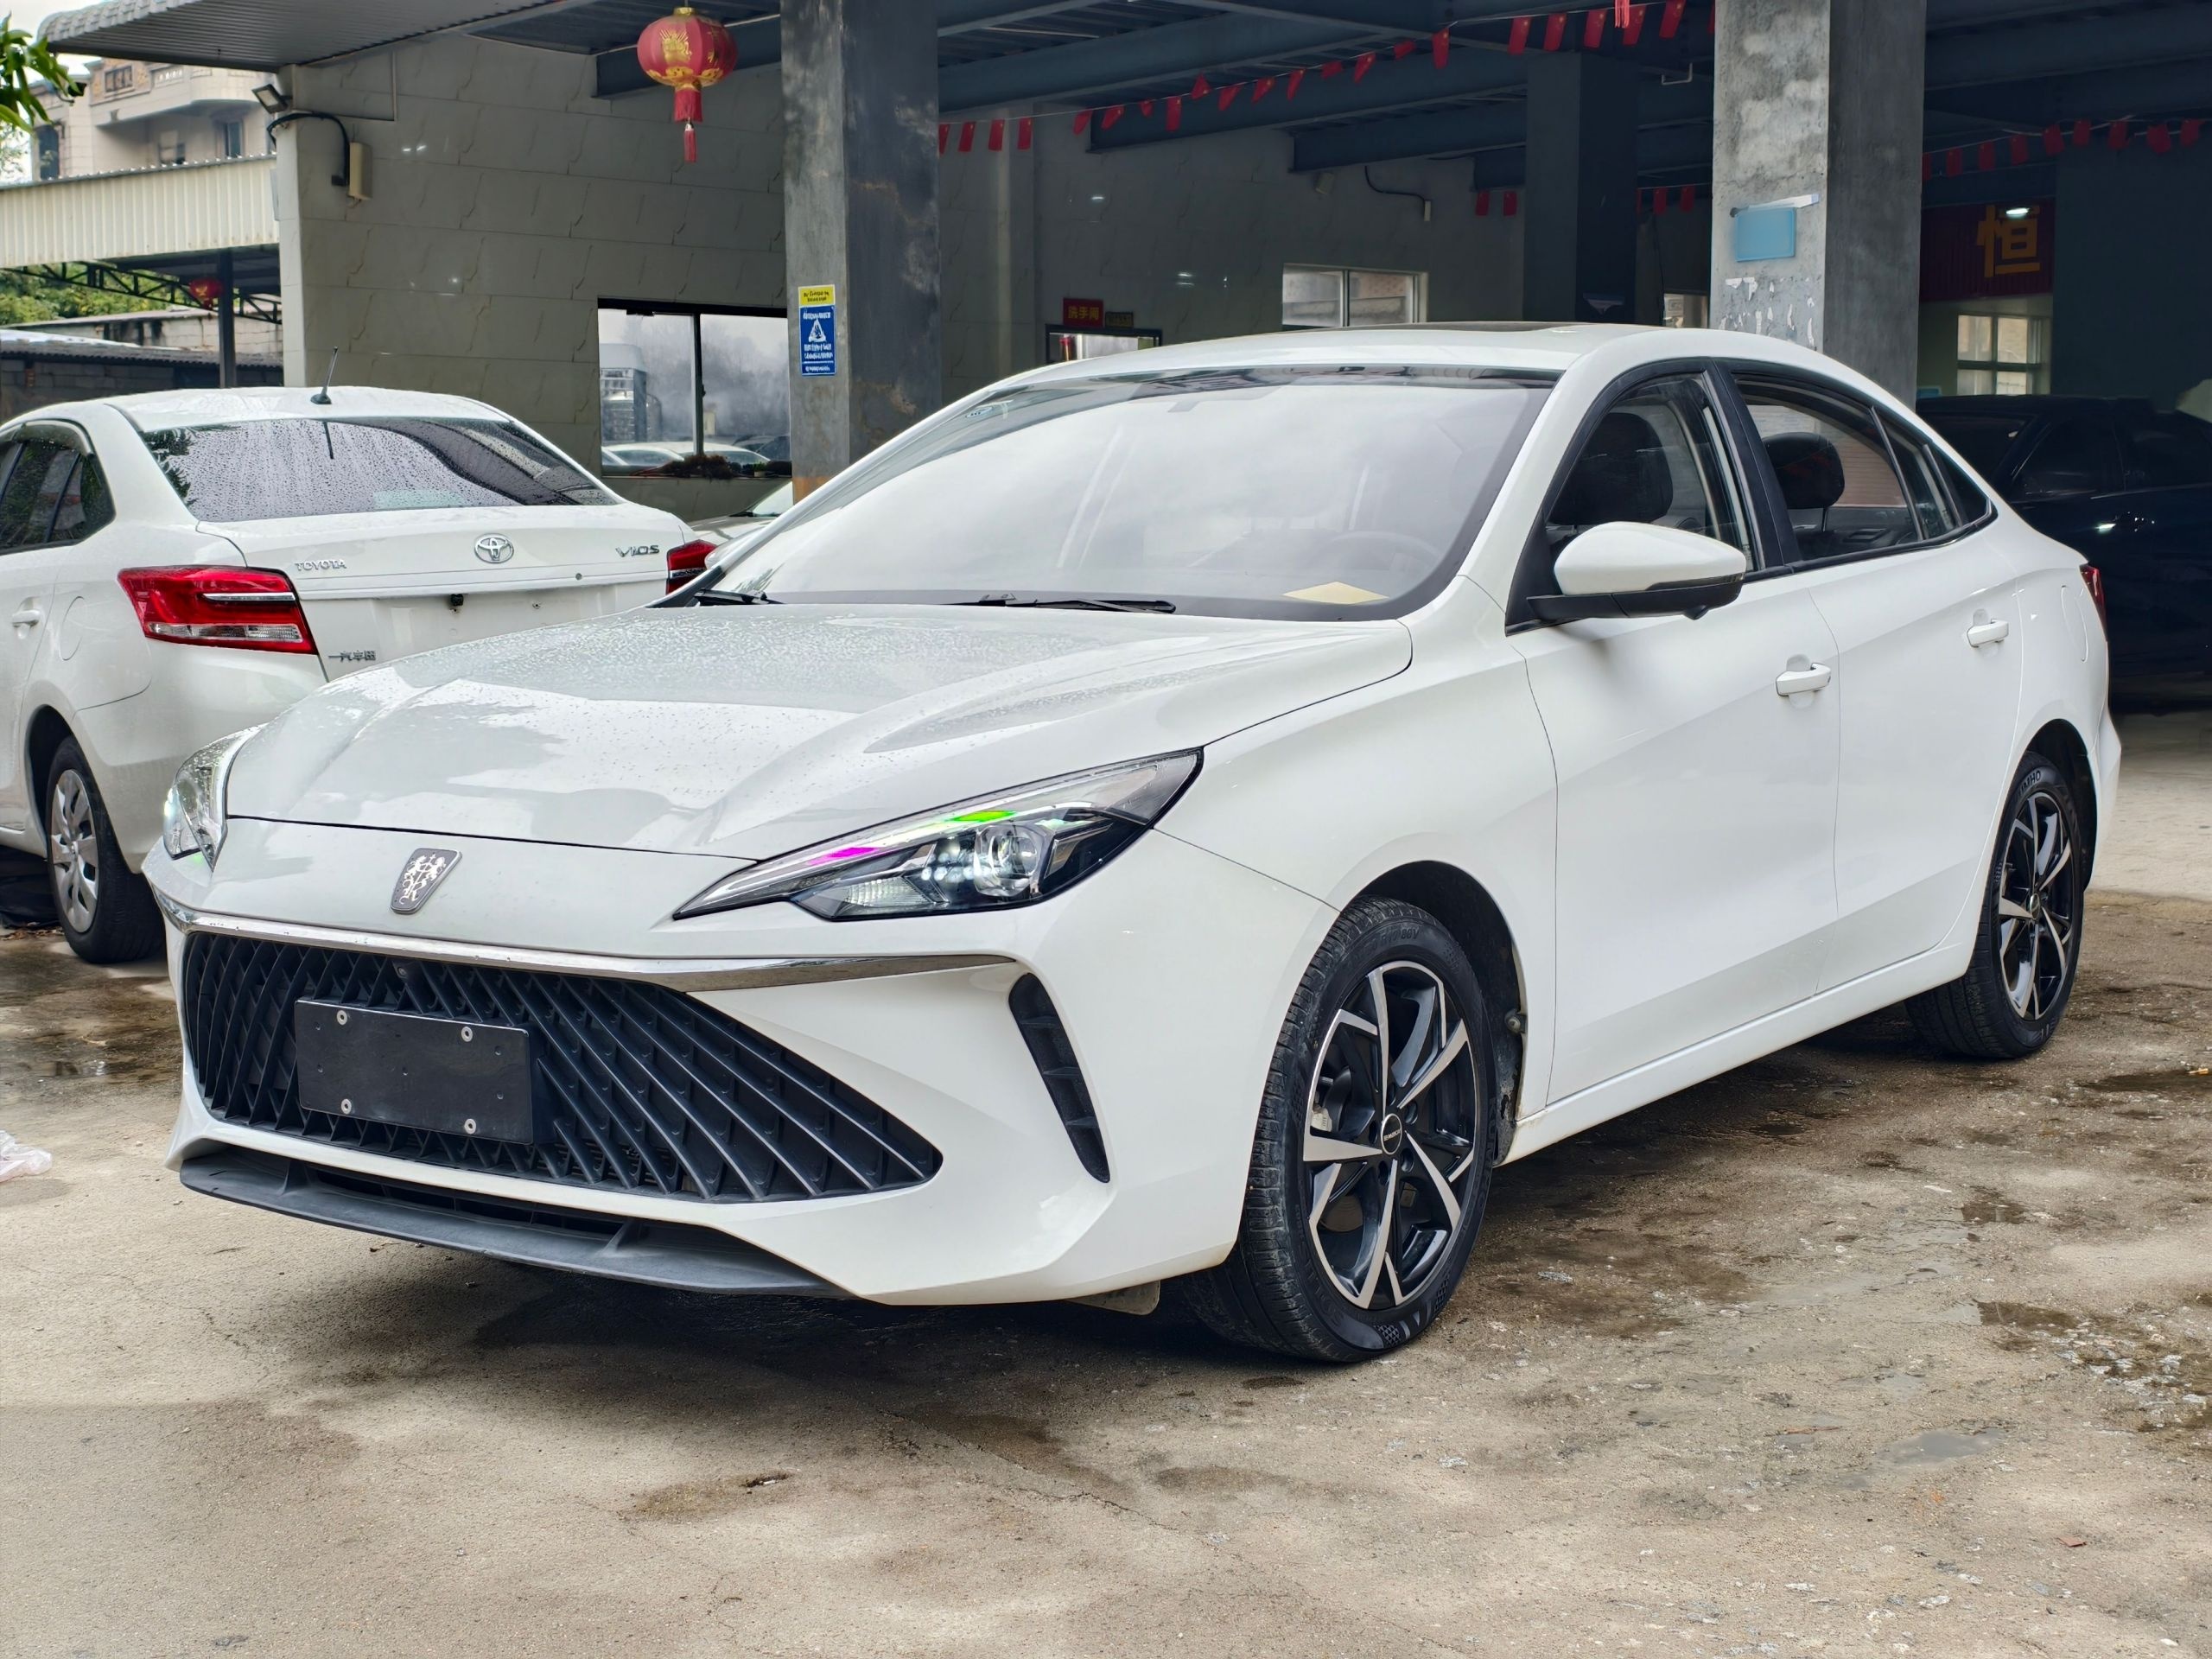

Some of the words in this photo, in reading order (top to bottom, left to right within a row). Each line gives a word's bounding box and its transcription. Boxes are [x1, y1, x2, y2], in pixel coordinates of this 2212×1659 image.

[1976, 205, 2040, 277] 恒
[615, 544, 660, 557] VIOS
[295, 560, 347, 571] TOYOTA
